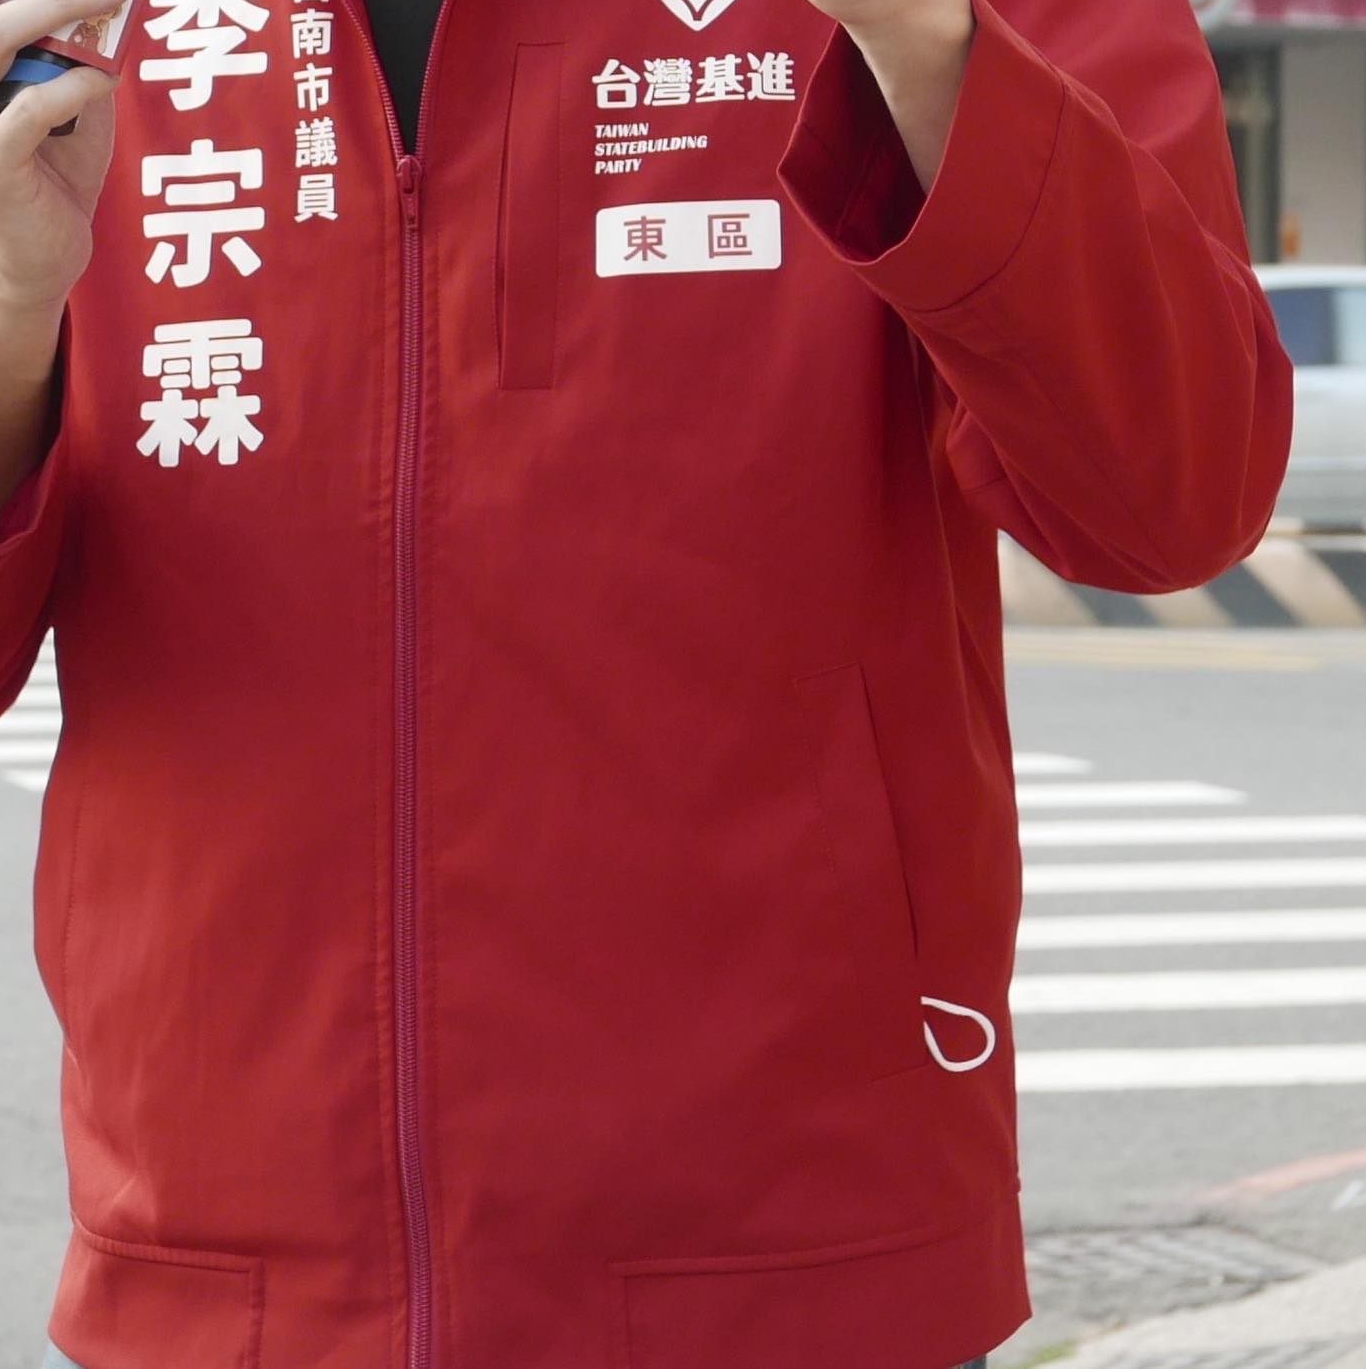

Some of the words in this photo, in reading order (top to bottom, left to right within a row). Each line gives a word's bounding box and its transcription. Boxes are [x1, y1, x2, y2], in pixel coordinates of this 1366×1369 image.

[592, 52, 796, 109] 台灣基進
[594, 123, 649, 139] TAIWAN
[594, 135, 708, 157] STATEBUILDING
[594, 158, 643, 175] PARTY
[623, 213, 753, 262] 東區
